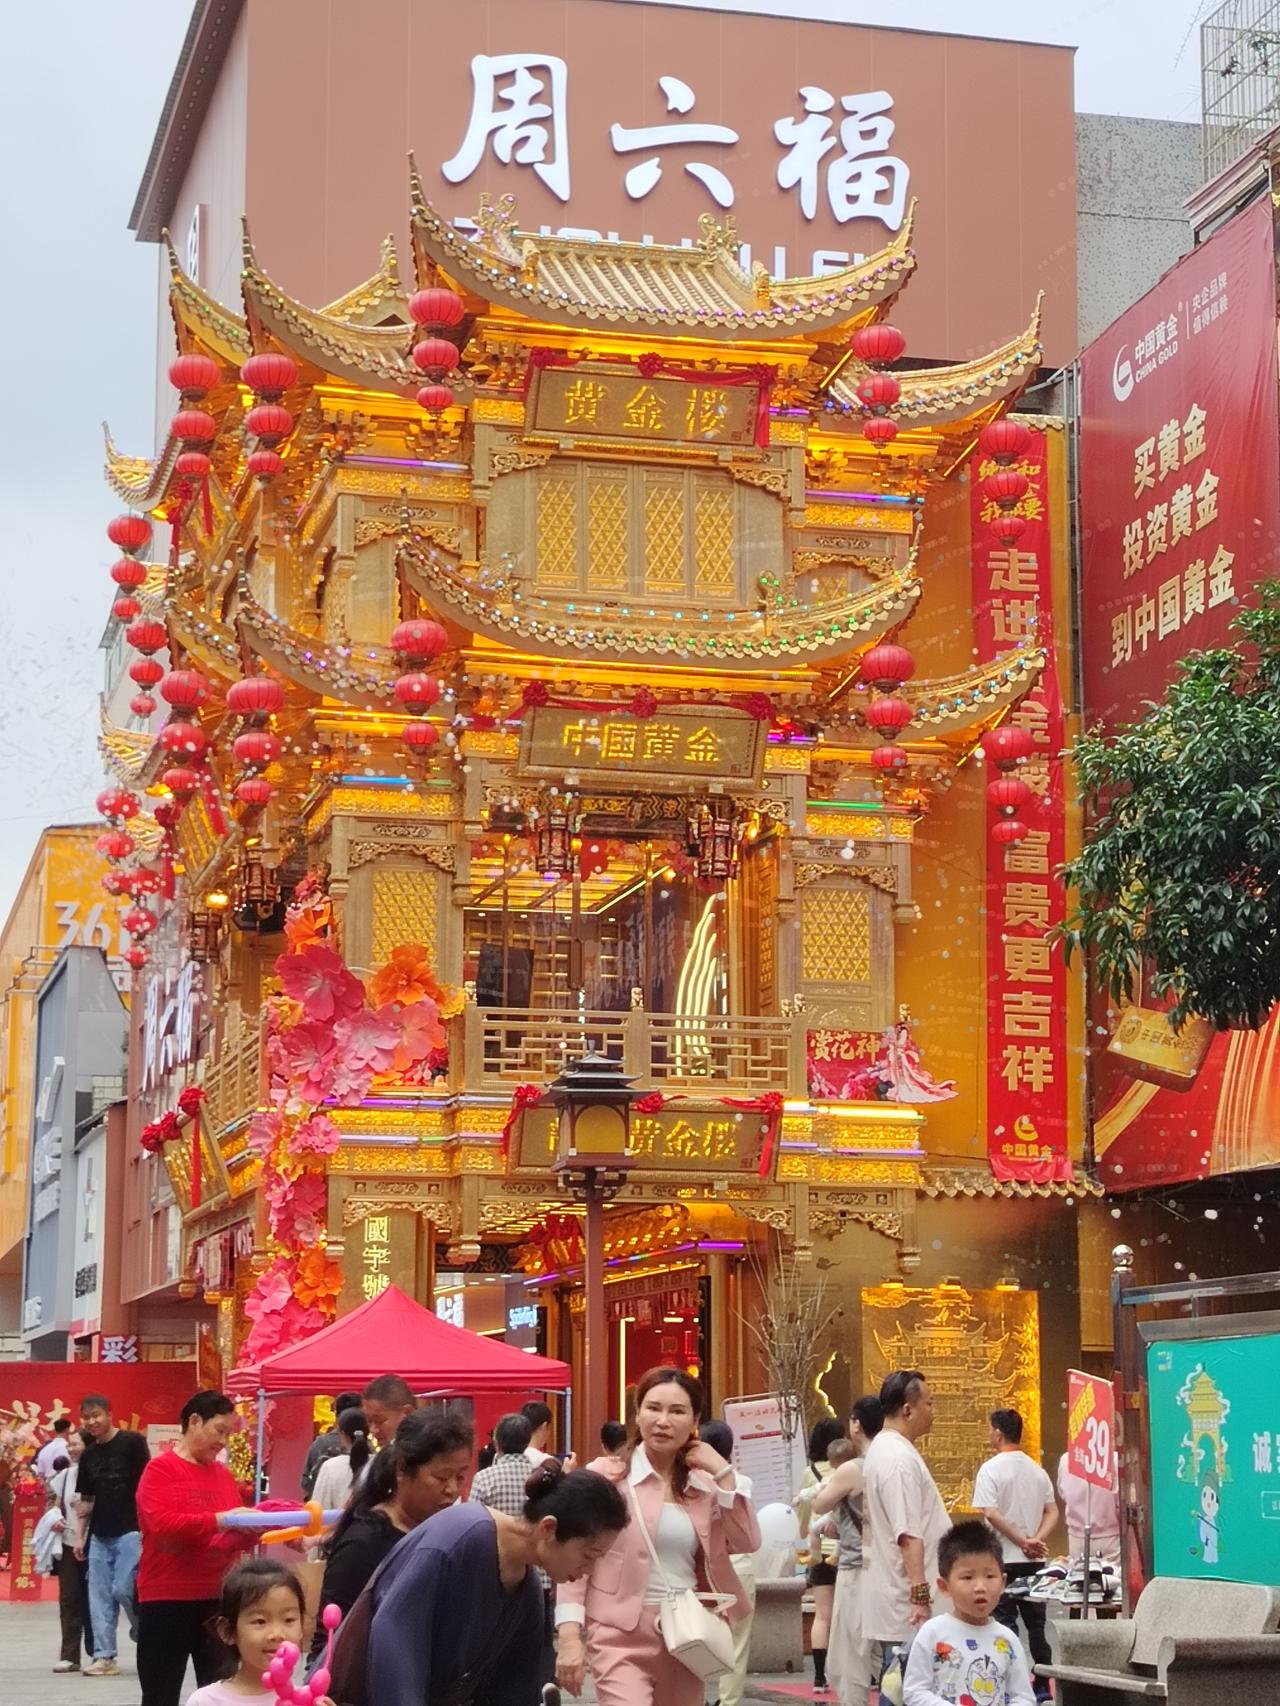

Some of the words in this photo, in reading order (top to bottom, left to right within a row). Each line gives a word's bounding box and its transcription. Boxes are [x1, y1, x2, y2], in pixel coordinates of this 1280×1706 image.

[441, 54, 911, 232] 周六福
[1135, 313, 1178, 365] 中国黄金
[1135, 357, 1157, 383] CHINA
[1158, 340, 1178, 364] GOLD
[1134, 402, 1207, 500] 买黄金
[1123, 468, 1219, 580] 投资黄金
[1111, 544, 1235, 668] 到中国黄金
[101, 1335, 139, 1364] 彩
[1085, 1416, 1109, 1479] 39
